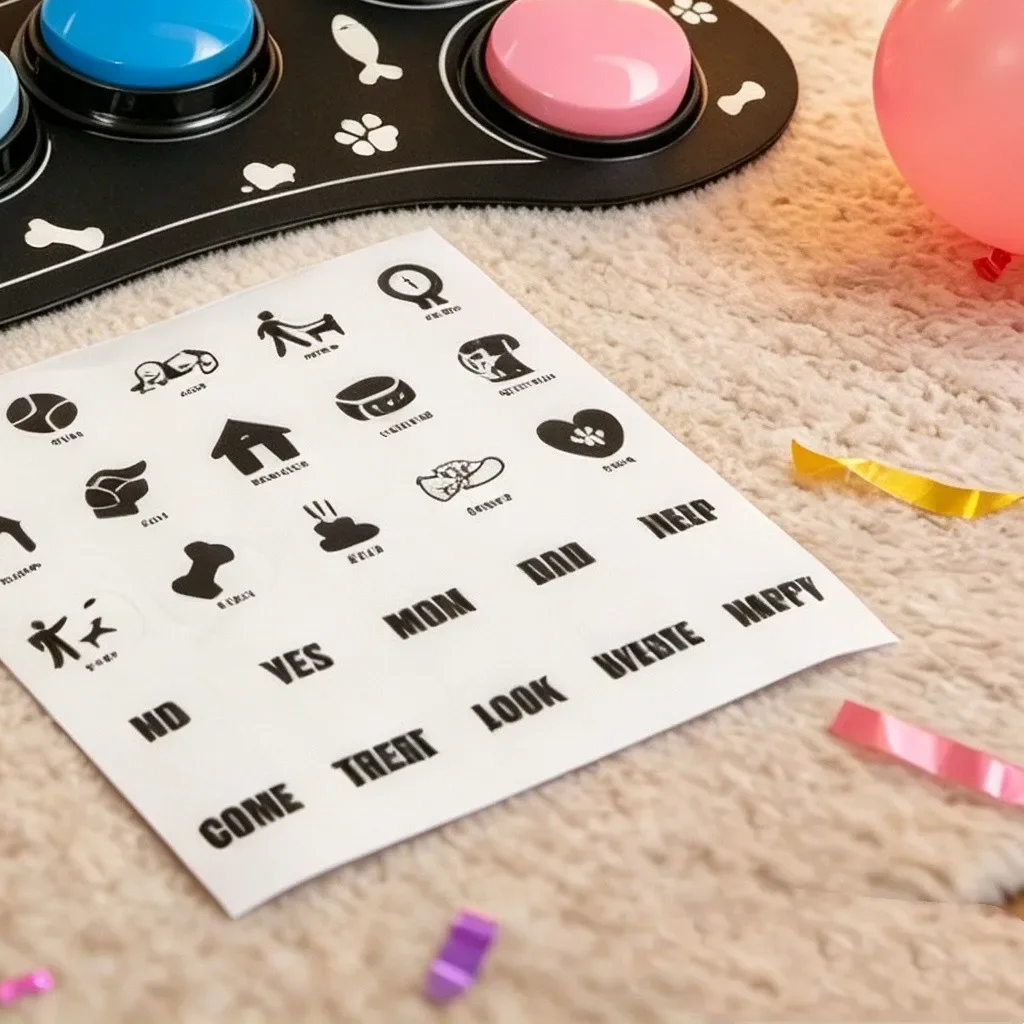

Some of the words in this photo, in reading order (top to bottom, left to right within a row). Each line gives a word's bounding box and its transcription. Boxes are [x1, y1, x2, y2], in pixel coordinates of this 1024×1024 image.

[258, 642, 335, 685] YES
[198, 783, 305, 850] COME
[470, 675, 569, 733] LOOK
